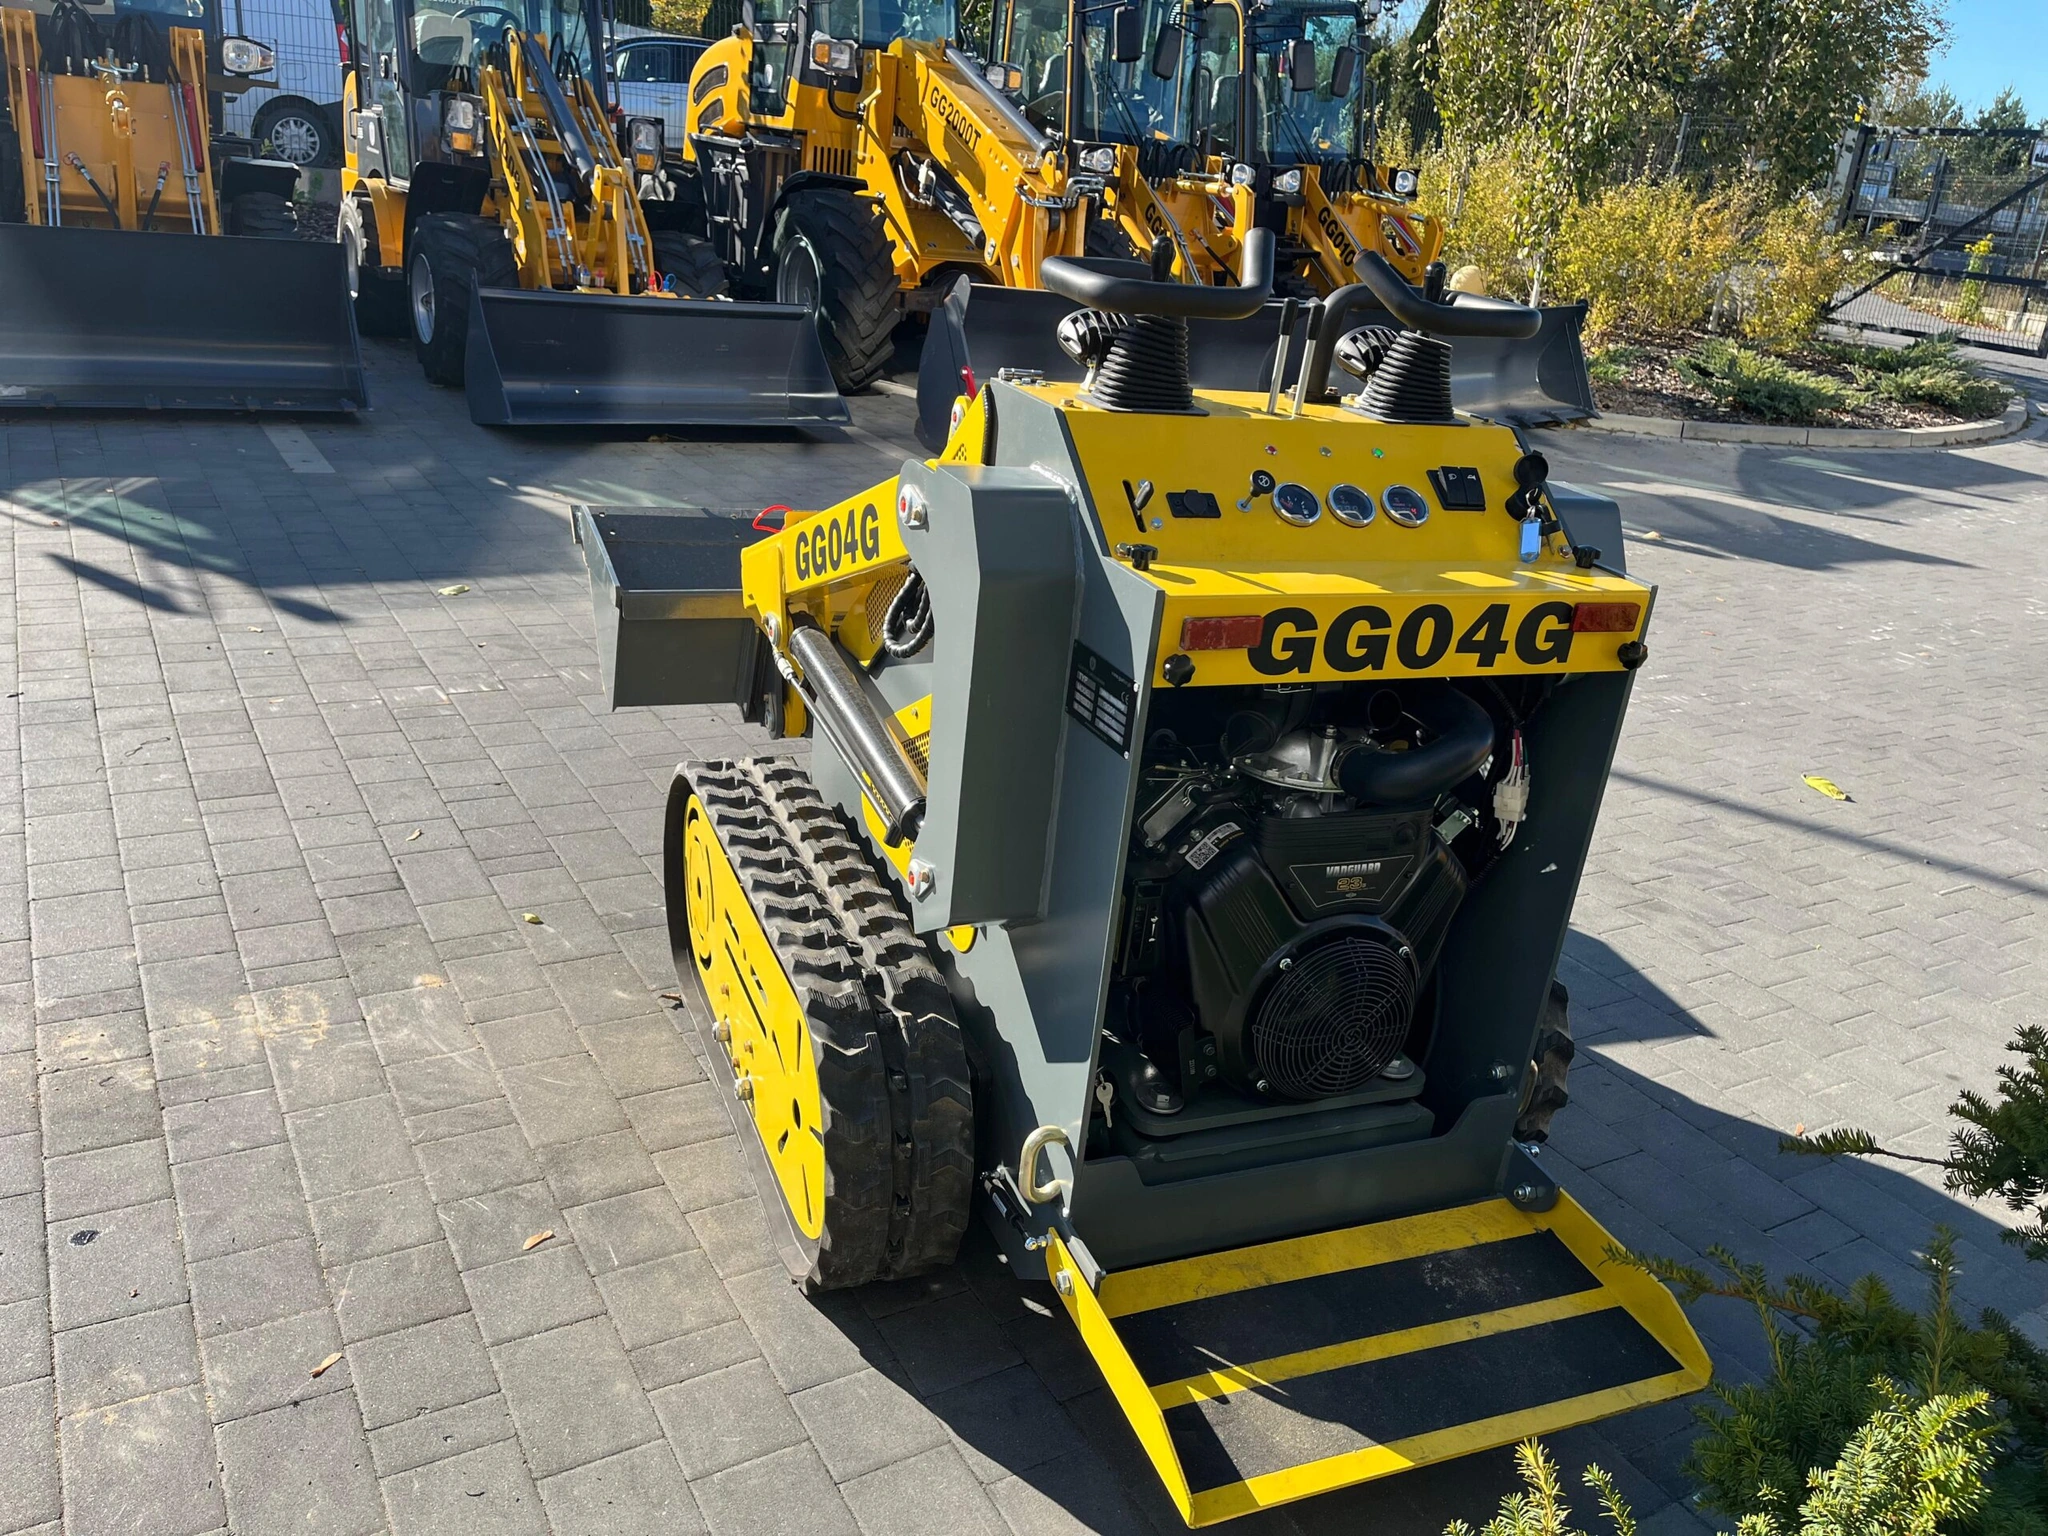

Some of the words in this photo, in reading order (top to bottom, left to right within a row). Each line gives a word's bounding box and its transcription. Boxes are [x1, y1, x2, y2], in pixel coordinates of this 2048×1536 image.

[930, 86, 981, 151] GG2000T
[1318, 206, 1357, 267] GG010
[795, 503, 880, 581] GG04G
[1247, 601, 1576, 676] GG04G
[1325, 862, 1381, 878] VANGUARD
